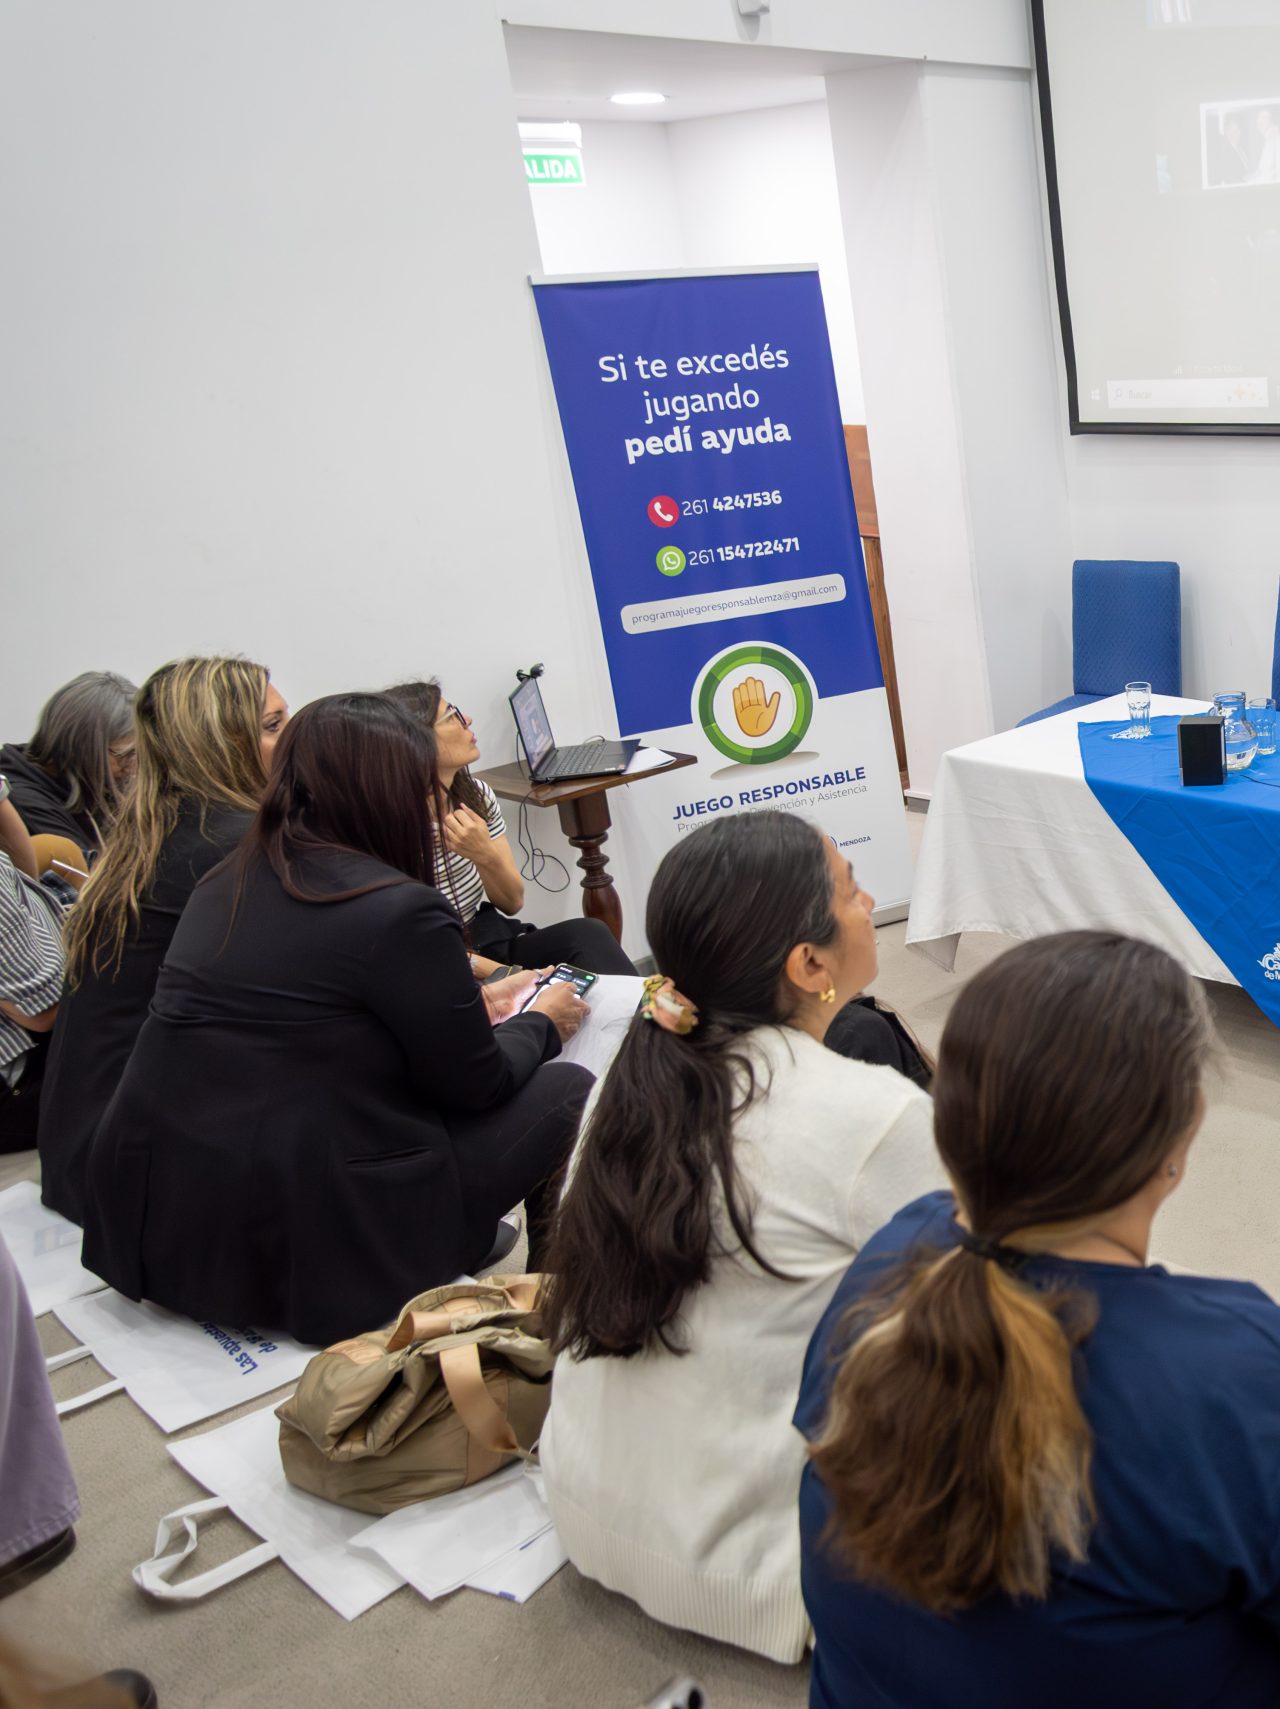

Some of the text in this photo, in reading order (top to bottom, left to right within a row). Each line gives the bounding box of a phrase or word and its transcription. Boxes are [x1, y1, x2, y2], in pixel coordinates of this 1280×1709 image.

[598, 343, 790, 383] Si te excedés
[643, 383, 760, 424] jugando
[624, 418, 792, 465] pedí ayuda
[682, 489, 783, 517] 261 4247536
[688, 537, 800, 566] 261 154722471
[631, 583, 838, 626] programajuegoresponsablemza@gmail.com
[672, 766, 866, 820] JUEGO RESPONSABLE
[810, 796, 816, 807] y
[817, 783, 868, 803] Asistencia
[839, 835, 872, 848] MENDOZA
[1264, 970, 1275, 980] de
[235, 1352, 258, 1375] Las
